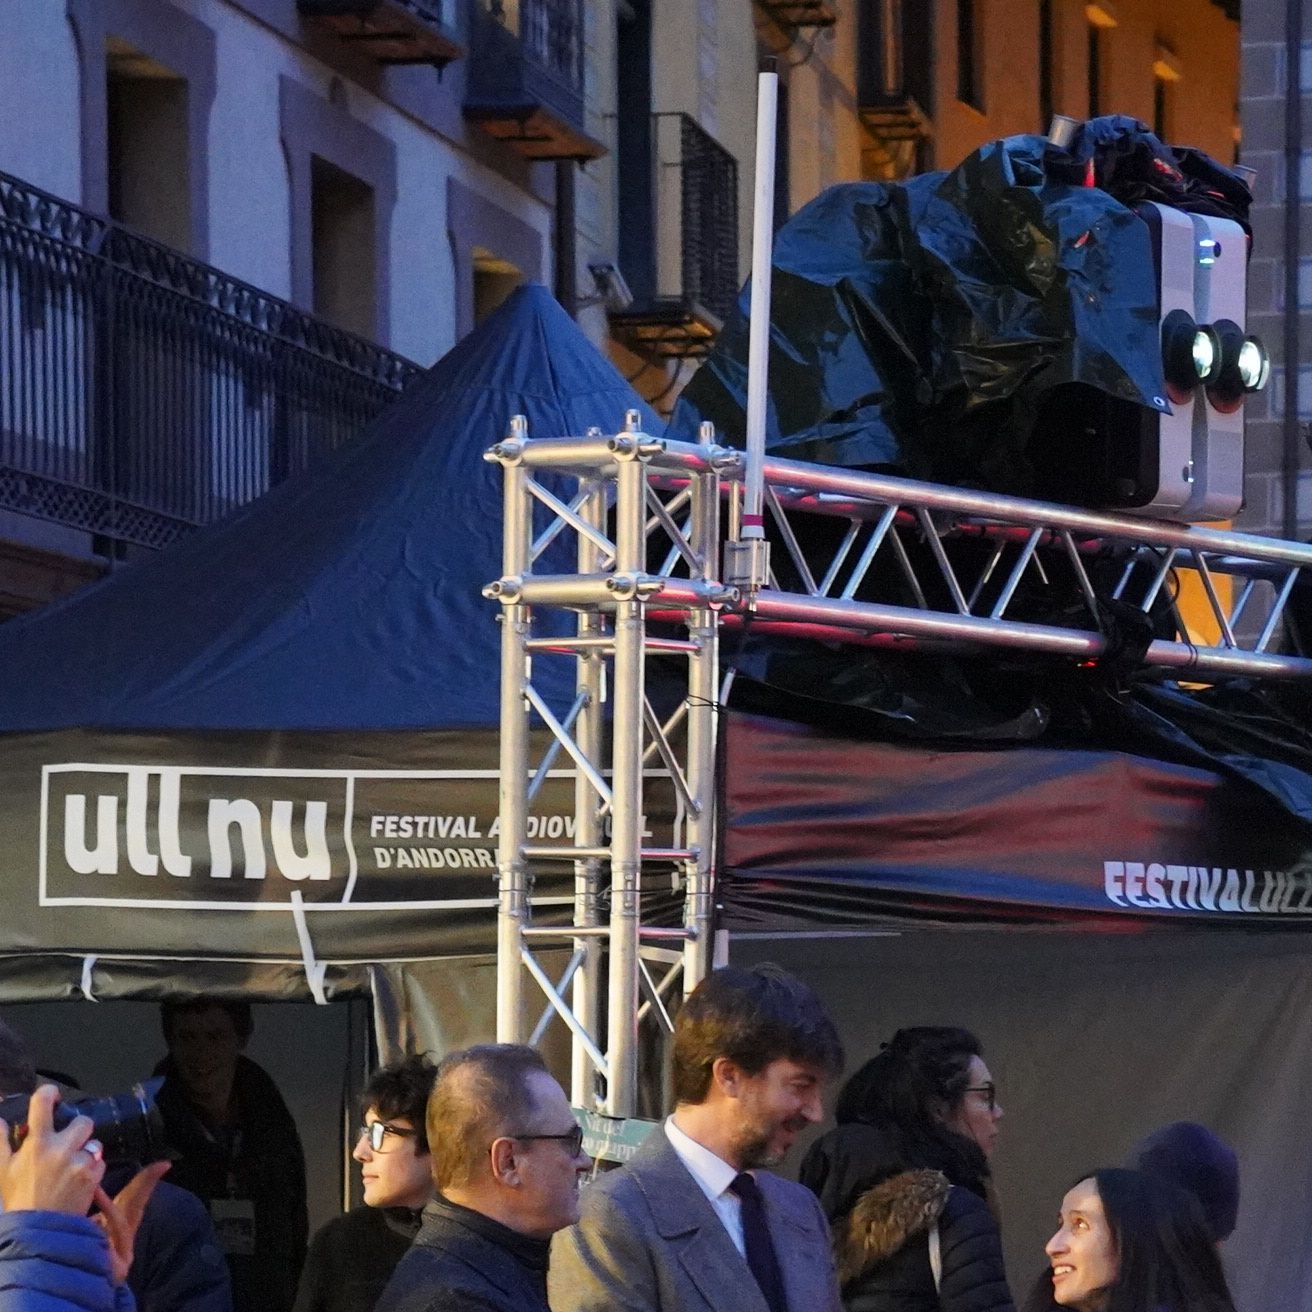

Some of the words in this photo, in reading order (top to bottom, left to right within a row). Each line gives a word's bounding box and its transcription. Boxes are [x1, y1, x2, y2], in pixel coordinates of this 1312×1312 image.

[64, 772, 192, 877] ull
[208, 799, 332, 880] nu
[370, 815, 482, 838] FESTIVAL
[372, 847, 500, 869] D'ANDORR
